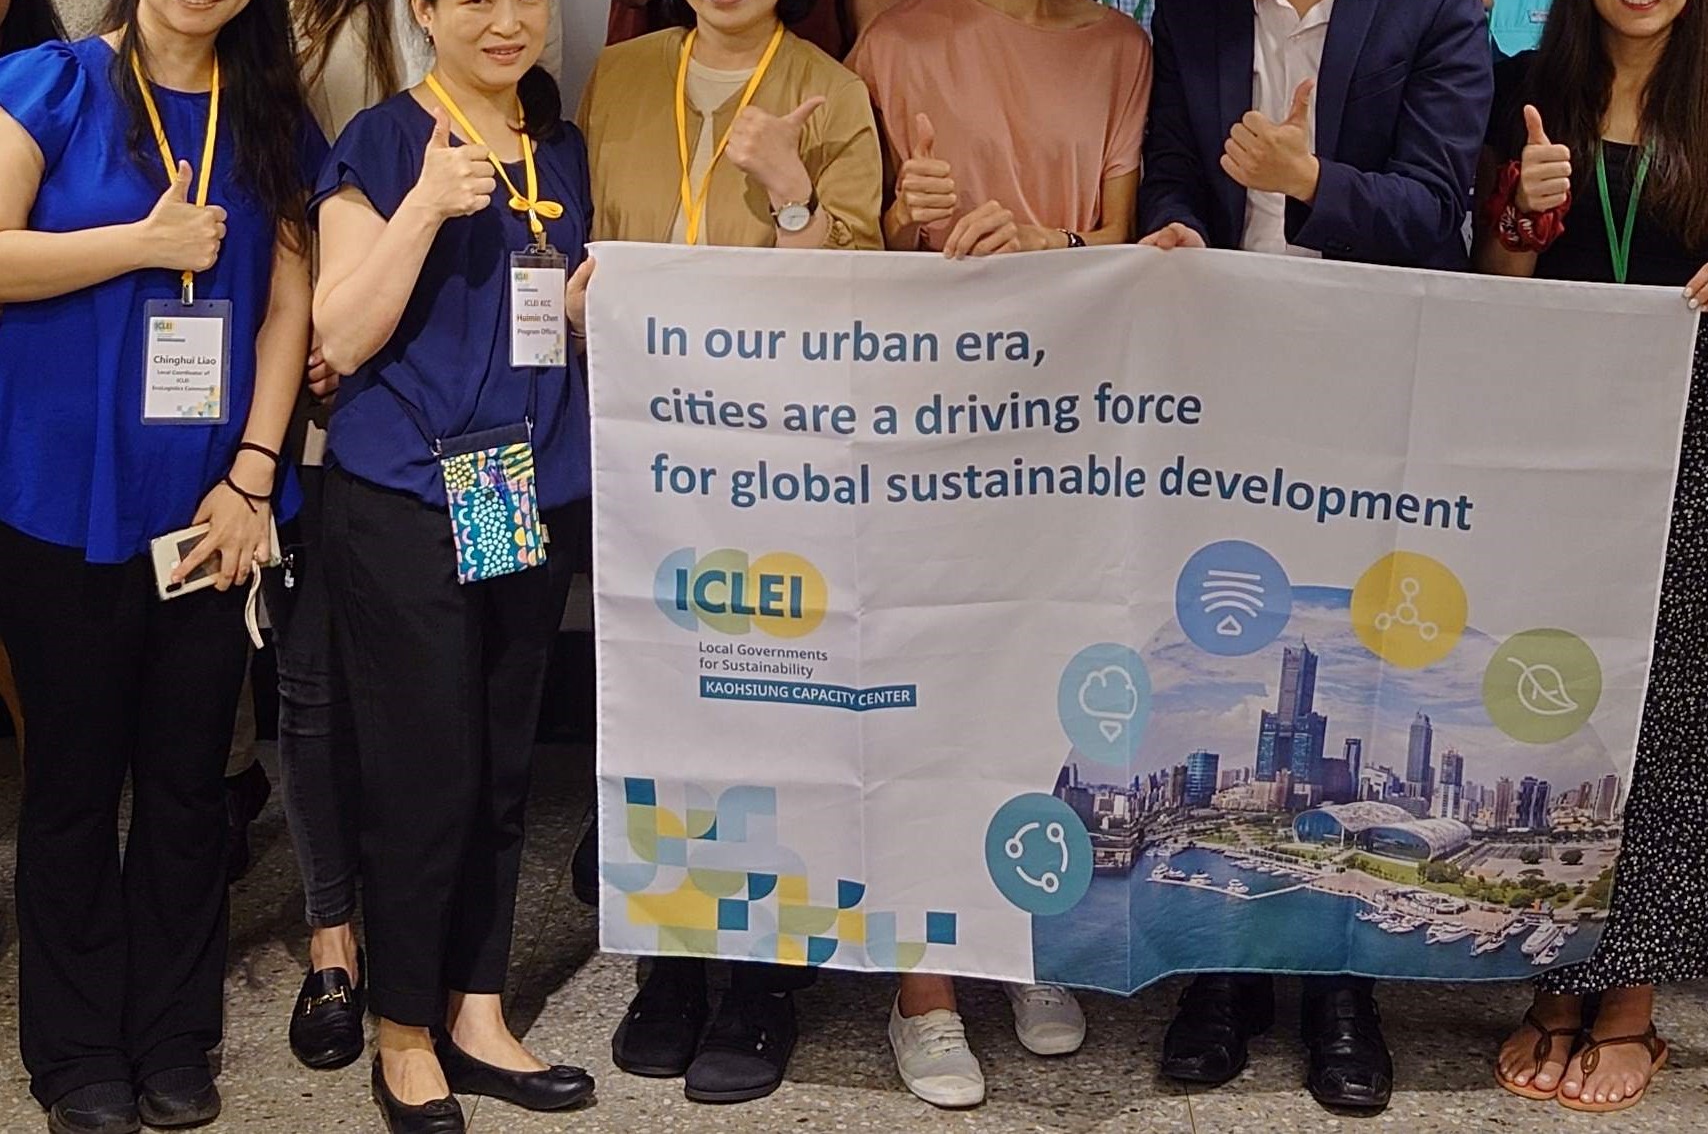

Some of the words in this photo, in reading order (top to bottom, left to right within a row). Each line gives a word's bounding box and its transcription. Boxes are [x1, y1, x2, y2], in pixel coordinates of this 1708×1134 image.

[542, 313, 559, 323] Chen
[648, 317, 687, 357] In
[704, 328, 786, 360] our
[802, 321, 938, 362] urban
[955, 331, 1045, 368] era,
[153, 355, 195, 366] Chinghui
[197, 356, 217, 365] Liao
[649, 388, 768, 430] cities
[783, 403, 857, 435] are
[873, 406, 898, 435] a
[915, 391, 1080, 435] driving
[1093, 382, 1202, 425] force
[651, 453, 717, 496] for
[730, 460, 870, 508] global
[886, 455, 1146, 503] sustainable
[1159, 455, 1474, 531] development
[675, 568, 803, 619] ICLEI
[698, 641, 734, 655] Local
[737, 644, 828, 662] Governments
[699, 657, 719, 670] for
[722, 659, 814, 678] Sustainability
[706, 681, 789, 698] KAOHSIUNG
[792, 687, 857, 705] CAPACITY
[858, 690, 911, 707] CENTER
